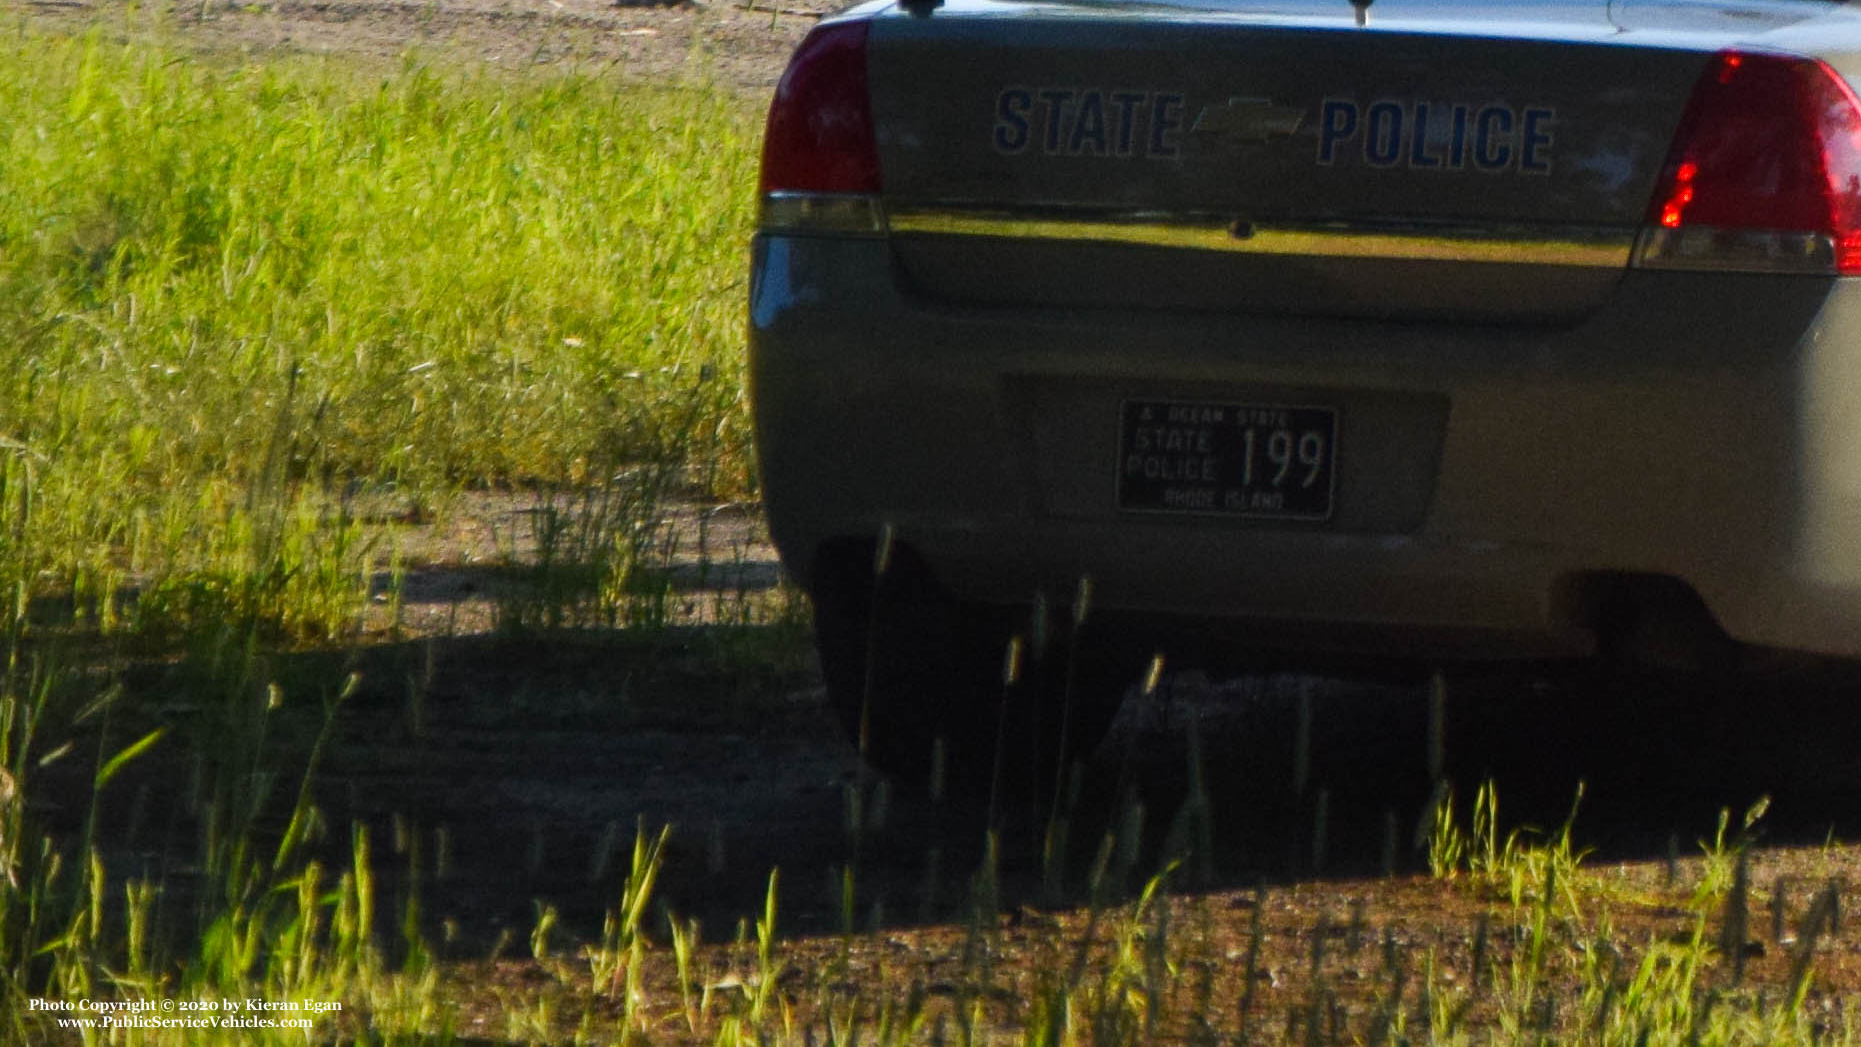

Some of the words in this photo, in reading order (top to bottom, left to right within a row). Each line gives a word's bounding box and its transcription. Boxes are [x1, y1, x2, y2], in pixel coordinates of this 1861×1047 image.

[992, 87, 1185, 158] STATE
[1316, 97, 1555, 175] POLICE
[1135, 426, 1210, 452] STATE
[1126, 454, 1217, 482] POLICE
[1241, 428, 1324, 488] 199
[1163, 489, 1216, 507] RHODE
[1224, 490, 1285, 509] ISLAND
